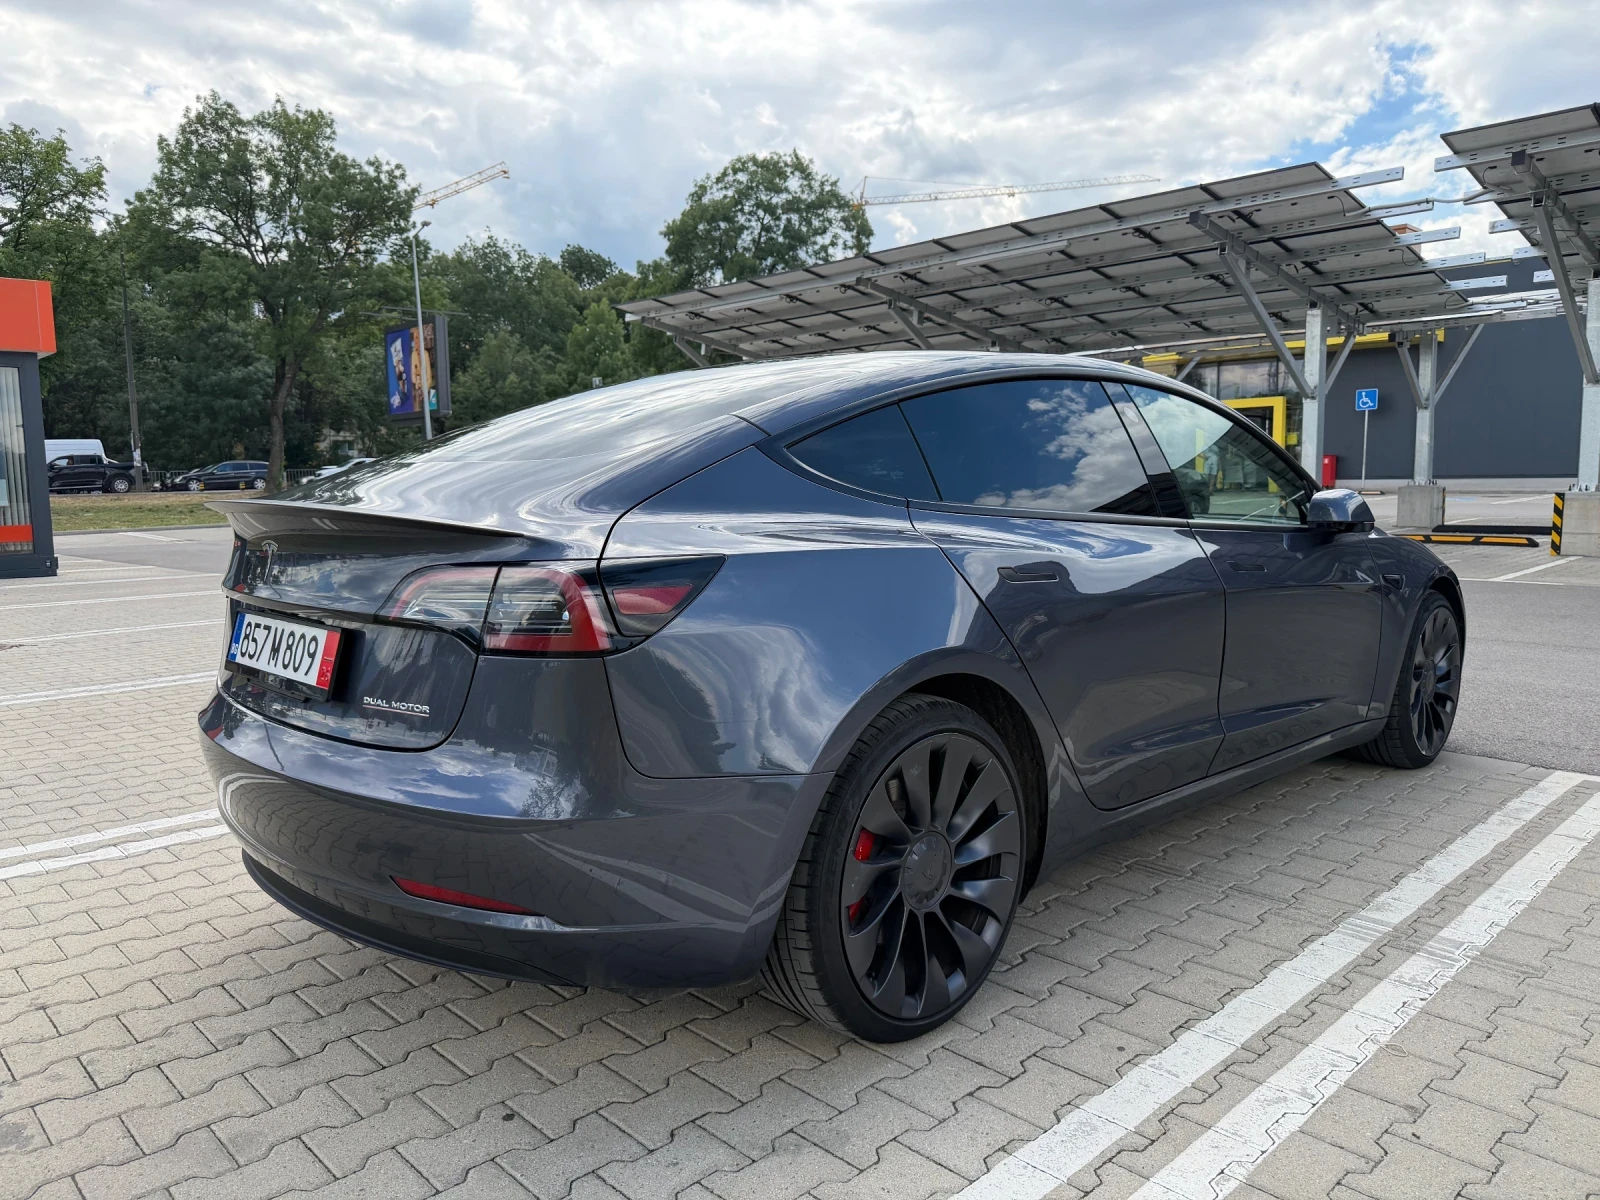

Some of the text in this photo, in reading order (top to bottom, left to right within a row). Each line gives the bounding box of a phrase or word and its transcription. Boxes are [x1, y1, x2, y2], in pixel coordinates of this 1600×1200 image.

[240, 621, 319, 676] 857M809
[363, 696, 430, 713] DUAL MOTOR
